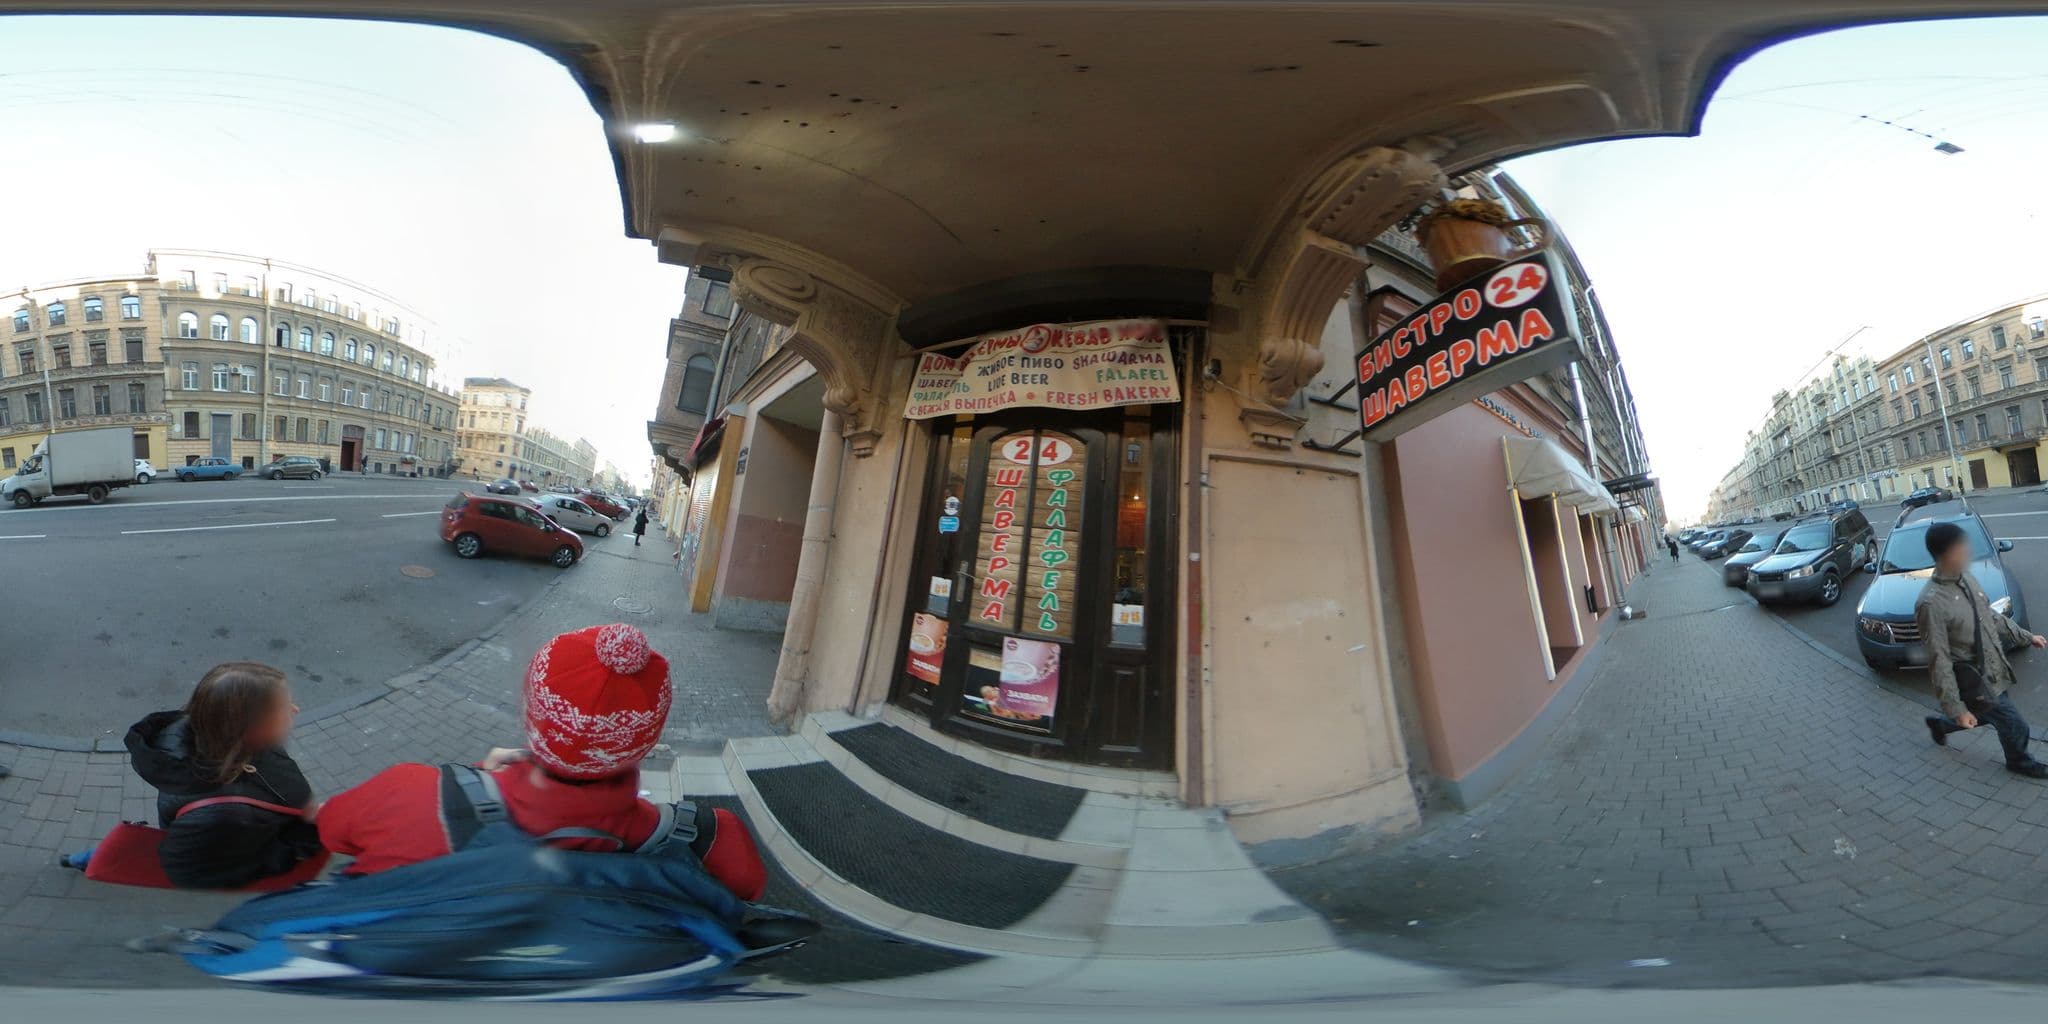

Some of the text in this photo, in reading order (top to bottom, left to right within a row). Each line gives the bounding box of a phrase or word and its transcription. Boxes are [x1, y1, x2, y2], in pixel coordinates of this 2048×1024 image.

[1360, 265, 1544, 383] БИСТРО 24
[920, 355, 956, 373] ДОМ
[977, 356, 1064, 376] ЖИВОЕ ПИВО
[1362, 308, 1554, 427] ШАВЕРМА
[1011, 372, 1049, 386] BEER
[1095, 368, 1169, 383] FALAFEL
[955, 391, 1017, 410] ВЫПЕЧКА
[1046, 386, 1172, 406] FRESH BAKERY
[980, 469, 1025, 621] ШАВЕРМА
[1037, 469, 1075, 631] ФАЛАФЕЛЬ
